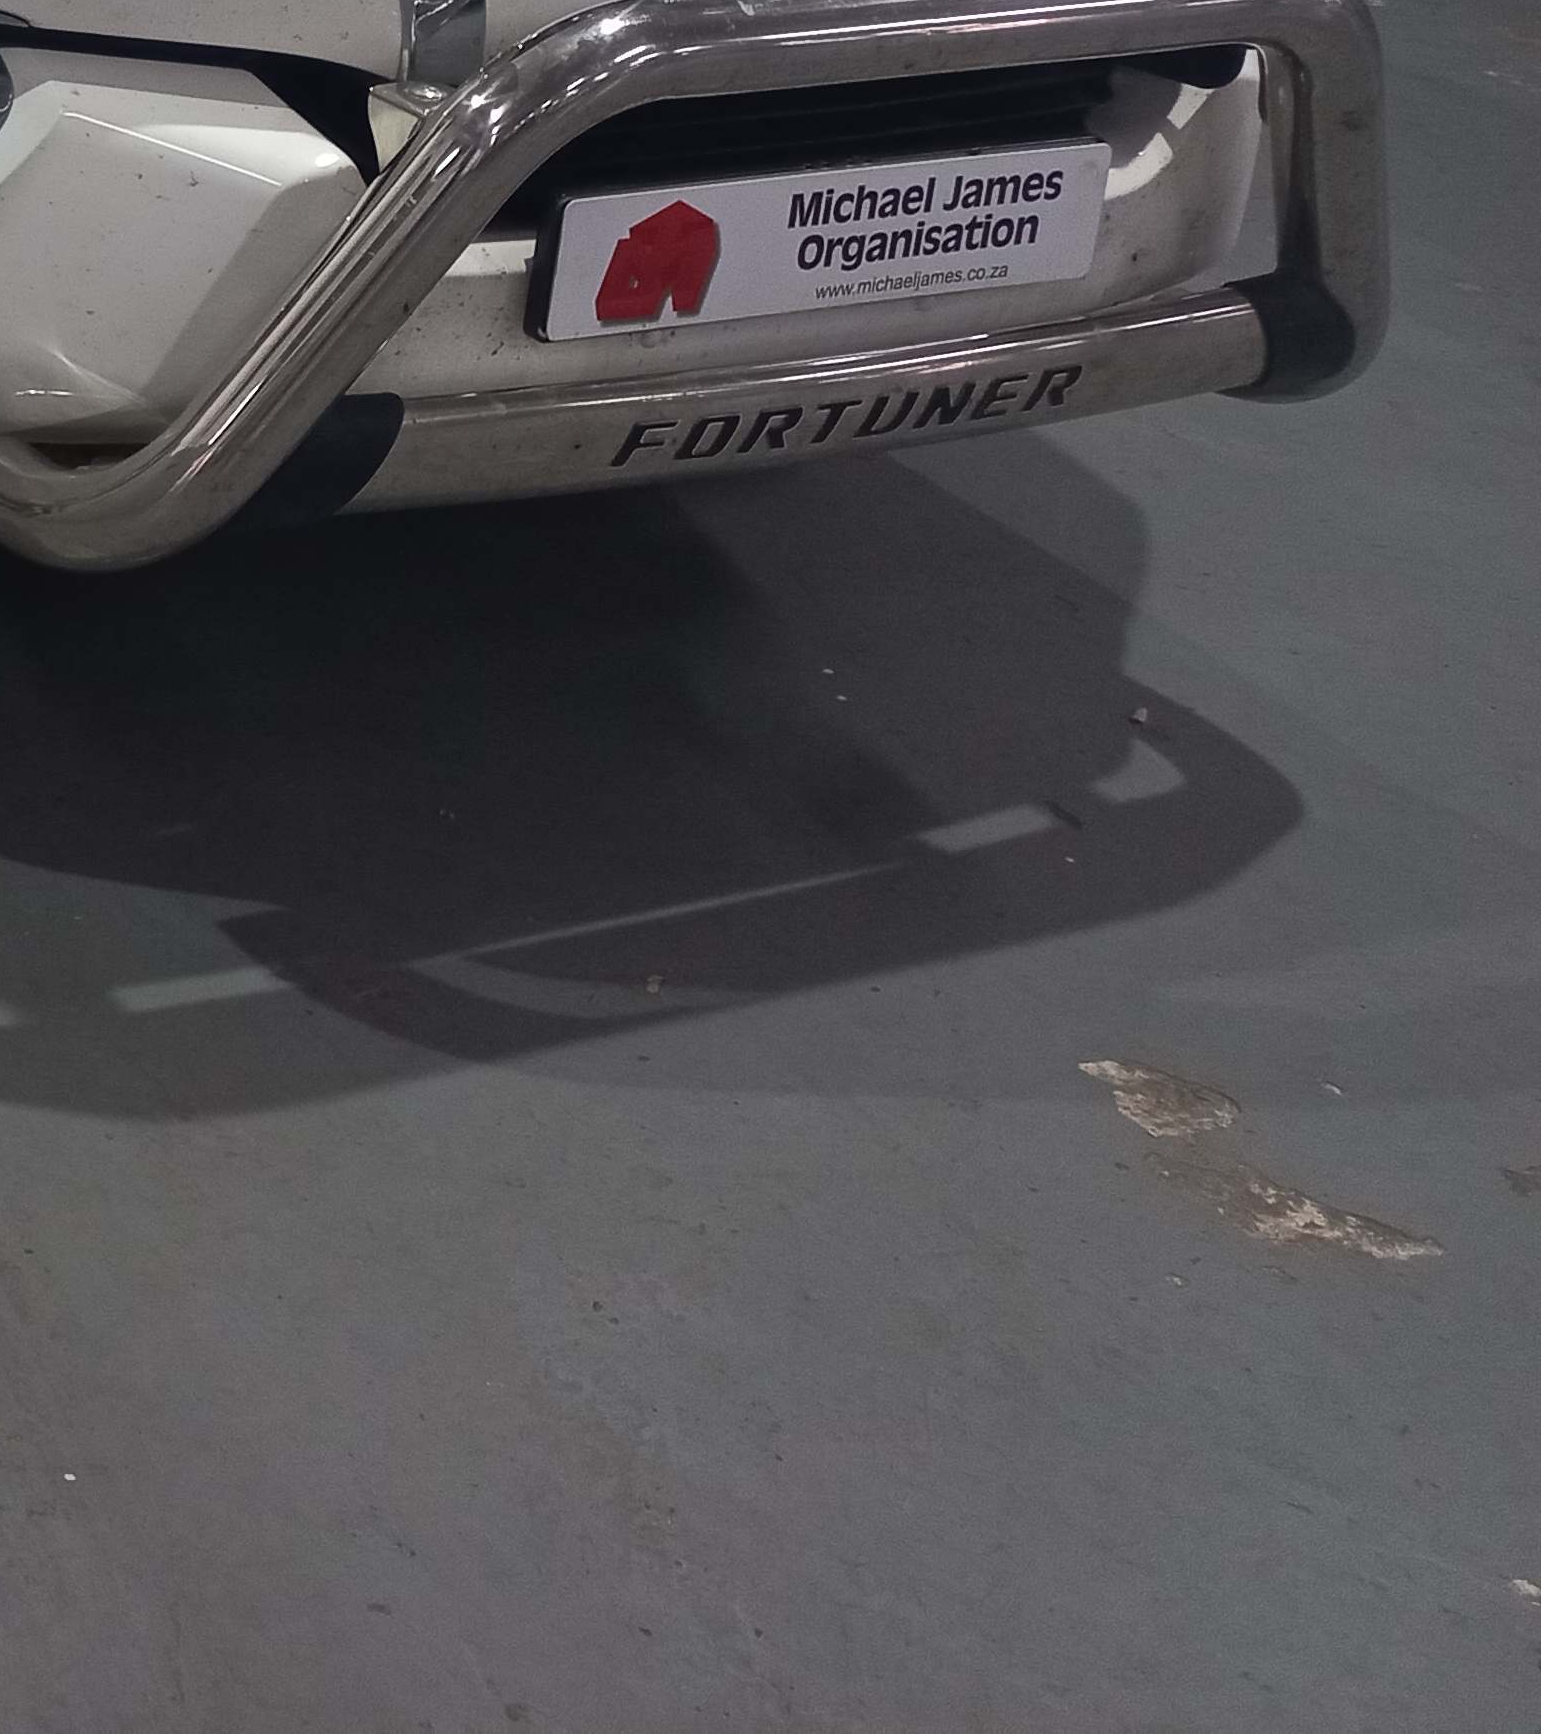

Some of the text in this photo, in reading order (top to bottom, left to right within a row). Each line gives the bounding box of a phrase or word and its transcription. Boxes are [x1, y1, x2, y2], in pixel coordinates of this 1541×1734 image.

[787, 170, 1063, 229] Michael James
[797, 213, 1039, 271] Organisation
[815, 265, 1008, 299] www.michaeljames.co.za
[611, 365, 1082, 466] FORTUNER
